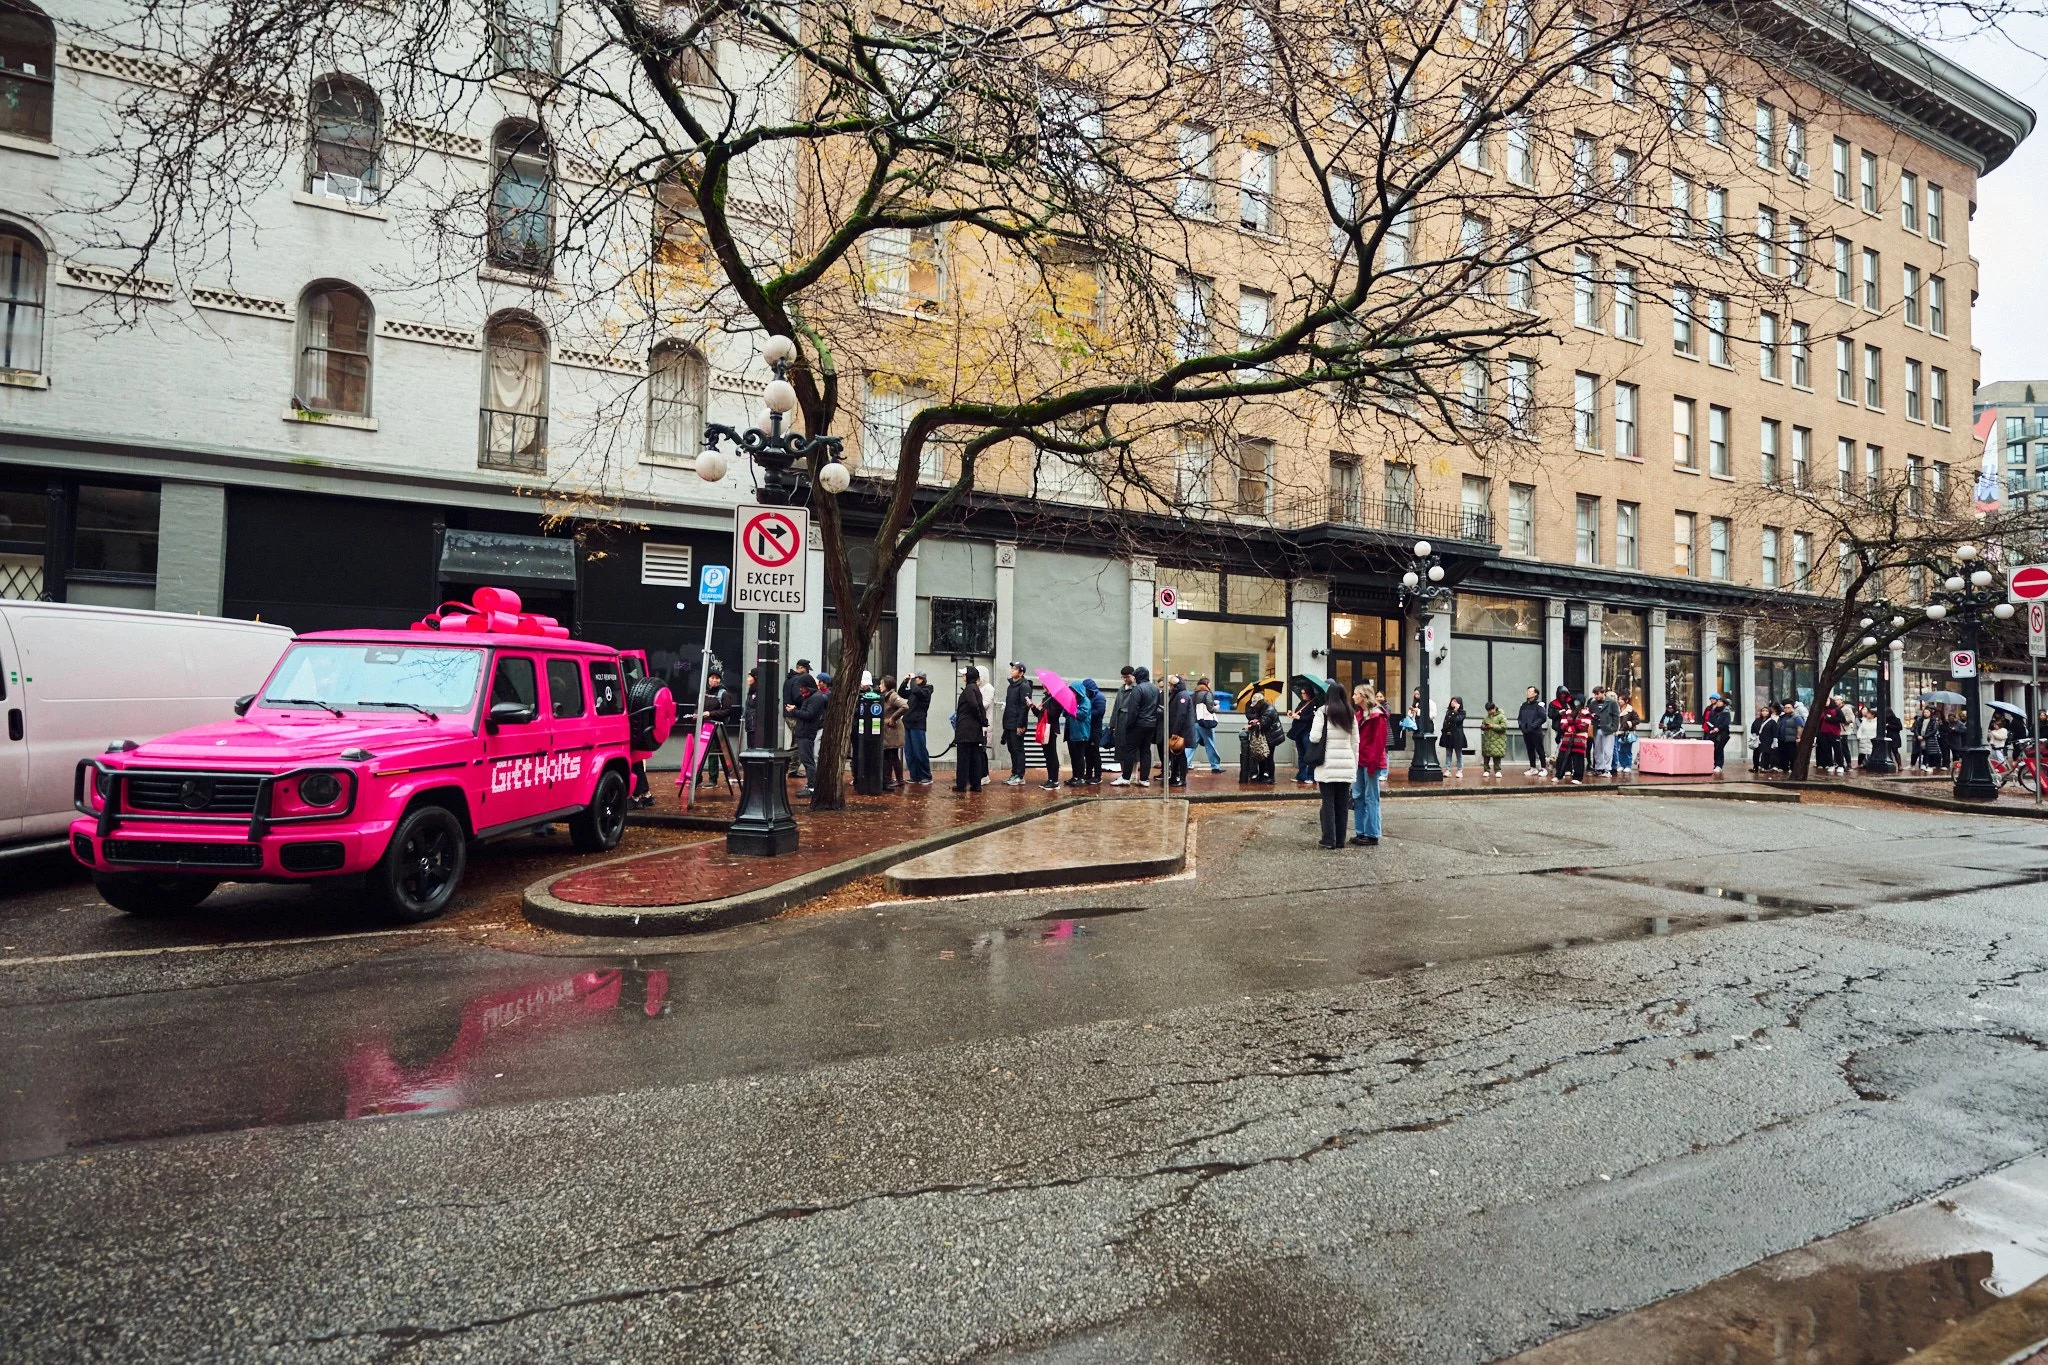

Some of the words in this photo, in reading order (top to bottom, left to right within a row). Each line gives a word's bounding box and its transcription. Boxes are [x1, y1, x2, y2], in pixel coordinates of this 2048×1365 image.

[710, 572, 718, 584] P
[747, 572, 794, 586] EXCEPT
[740, 588, 801, 604] BICYCLES
[491, 758, 532, 794] Gift
[534, 752, 581, 786] Holts
